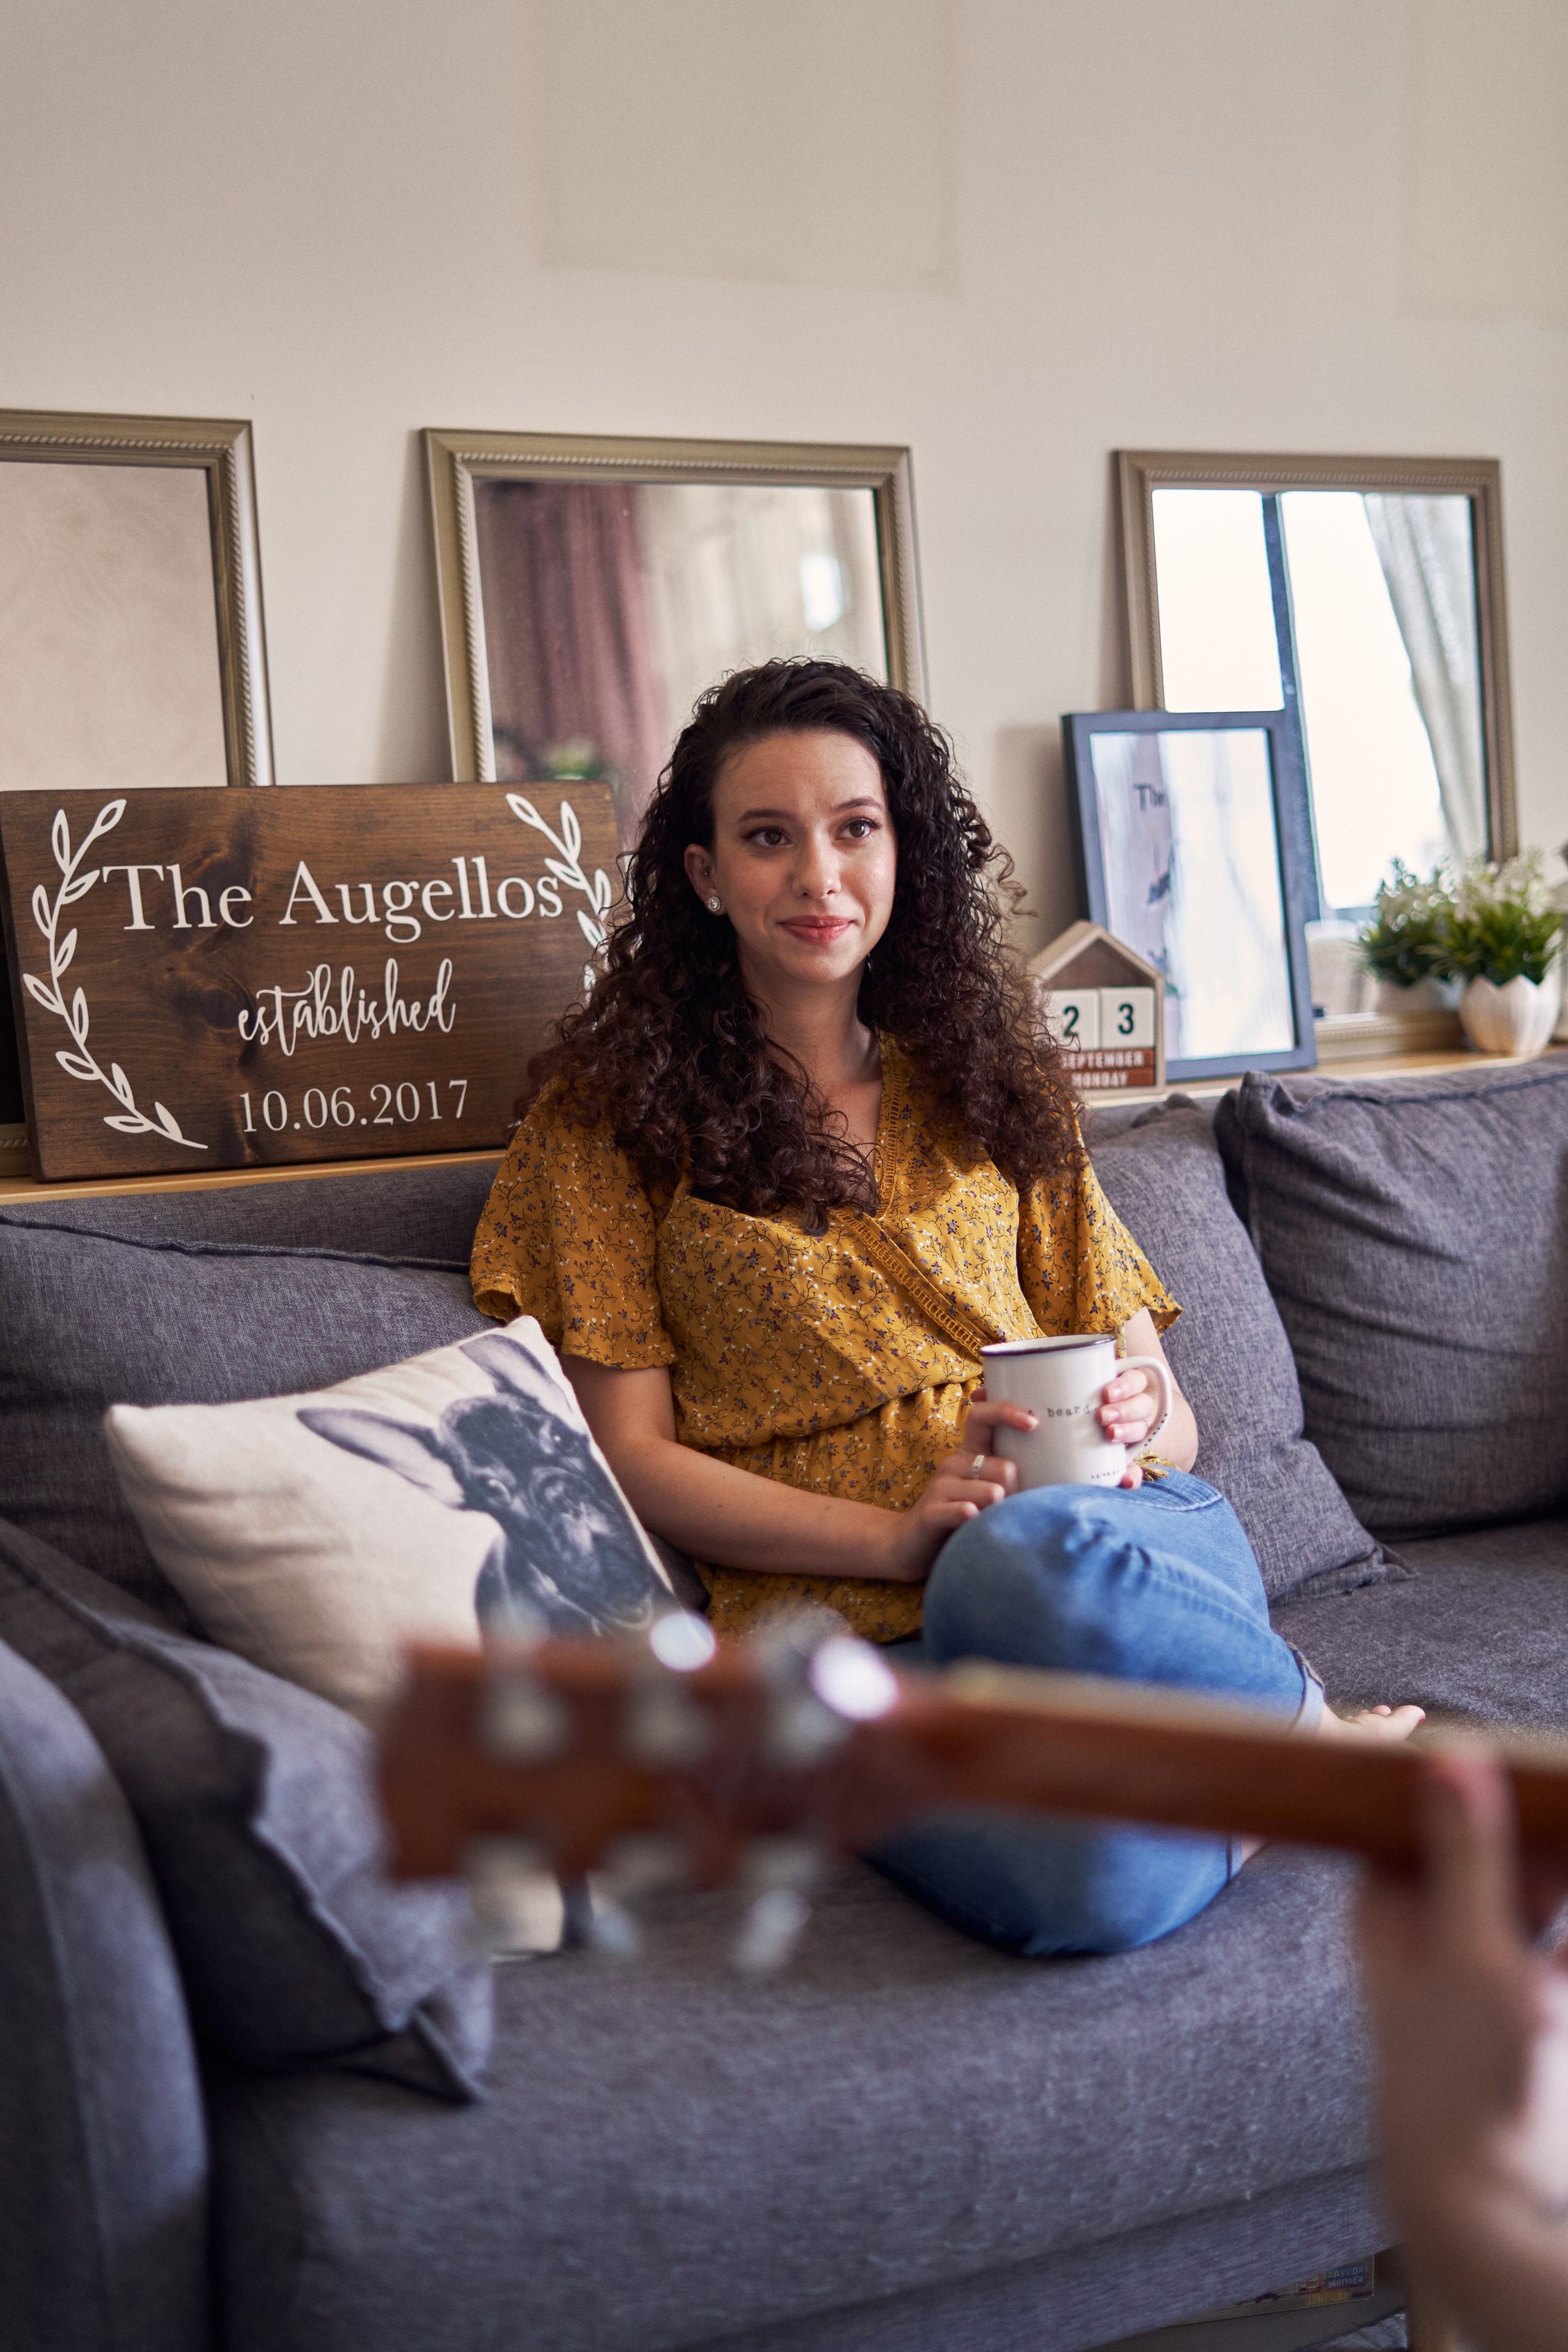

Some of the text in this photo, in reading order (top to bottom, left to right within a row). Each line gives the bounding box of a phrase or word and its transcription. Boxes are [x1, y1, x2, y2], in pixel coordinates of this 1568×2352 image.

[102, 855, 564, 943] The Augellos
[238, 957, 456, 1057] established
[239, 1079, 468, 1133] 10.06.2017
[1072, 1072, 1128, 1088] MONDAY
[1046, 1404, 1090, 1417] beard
